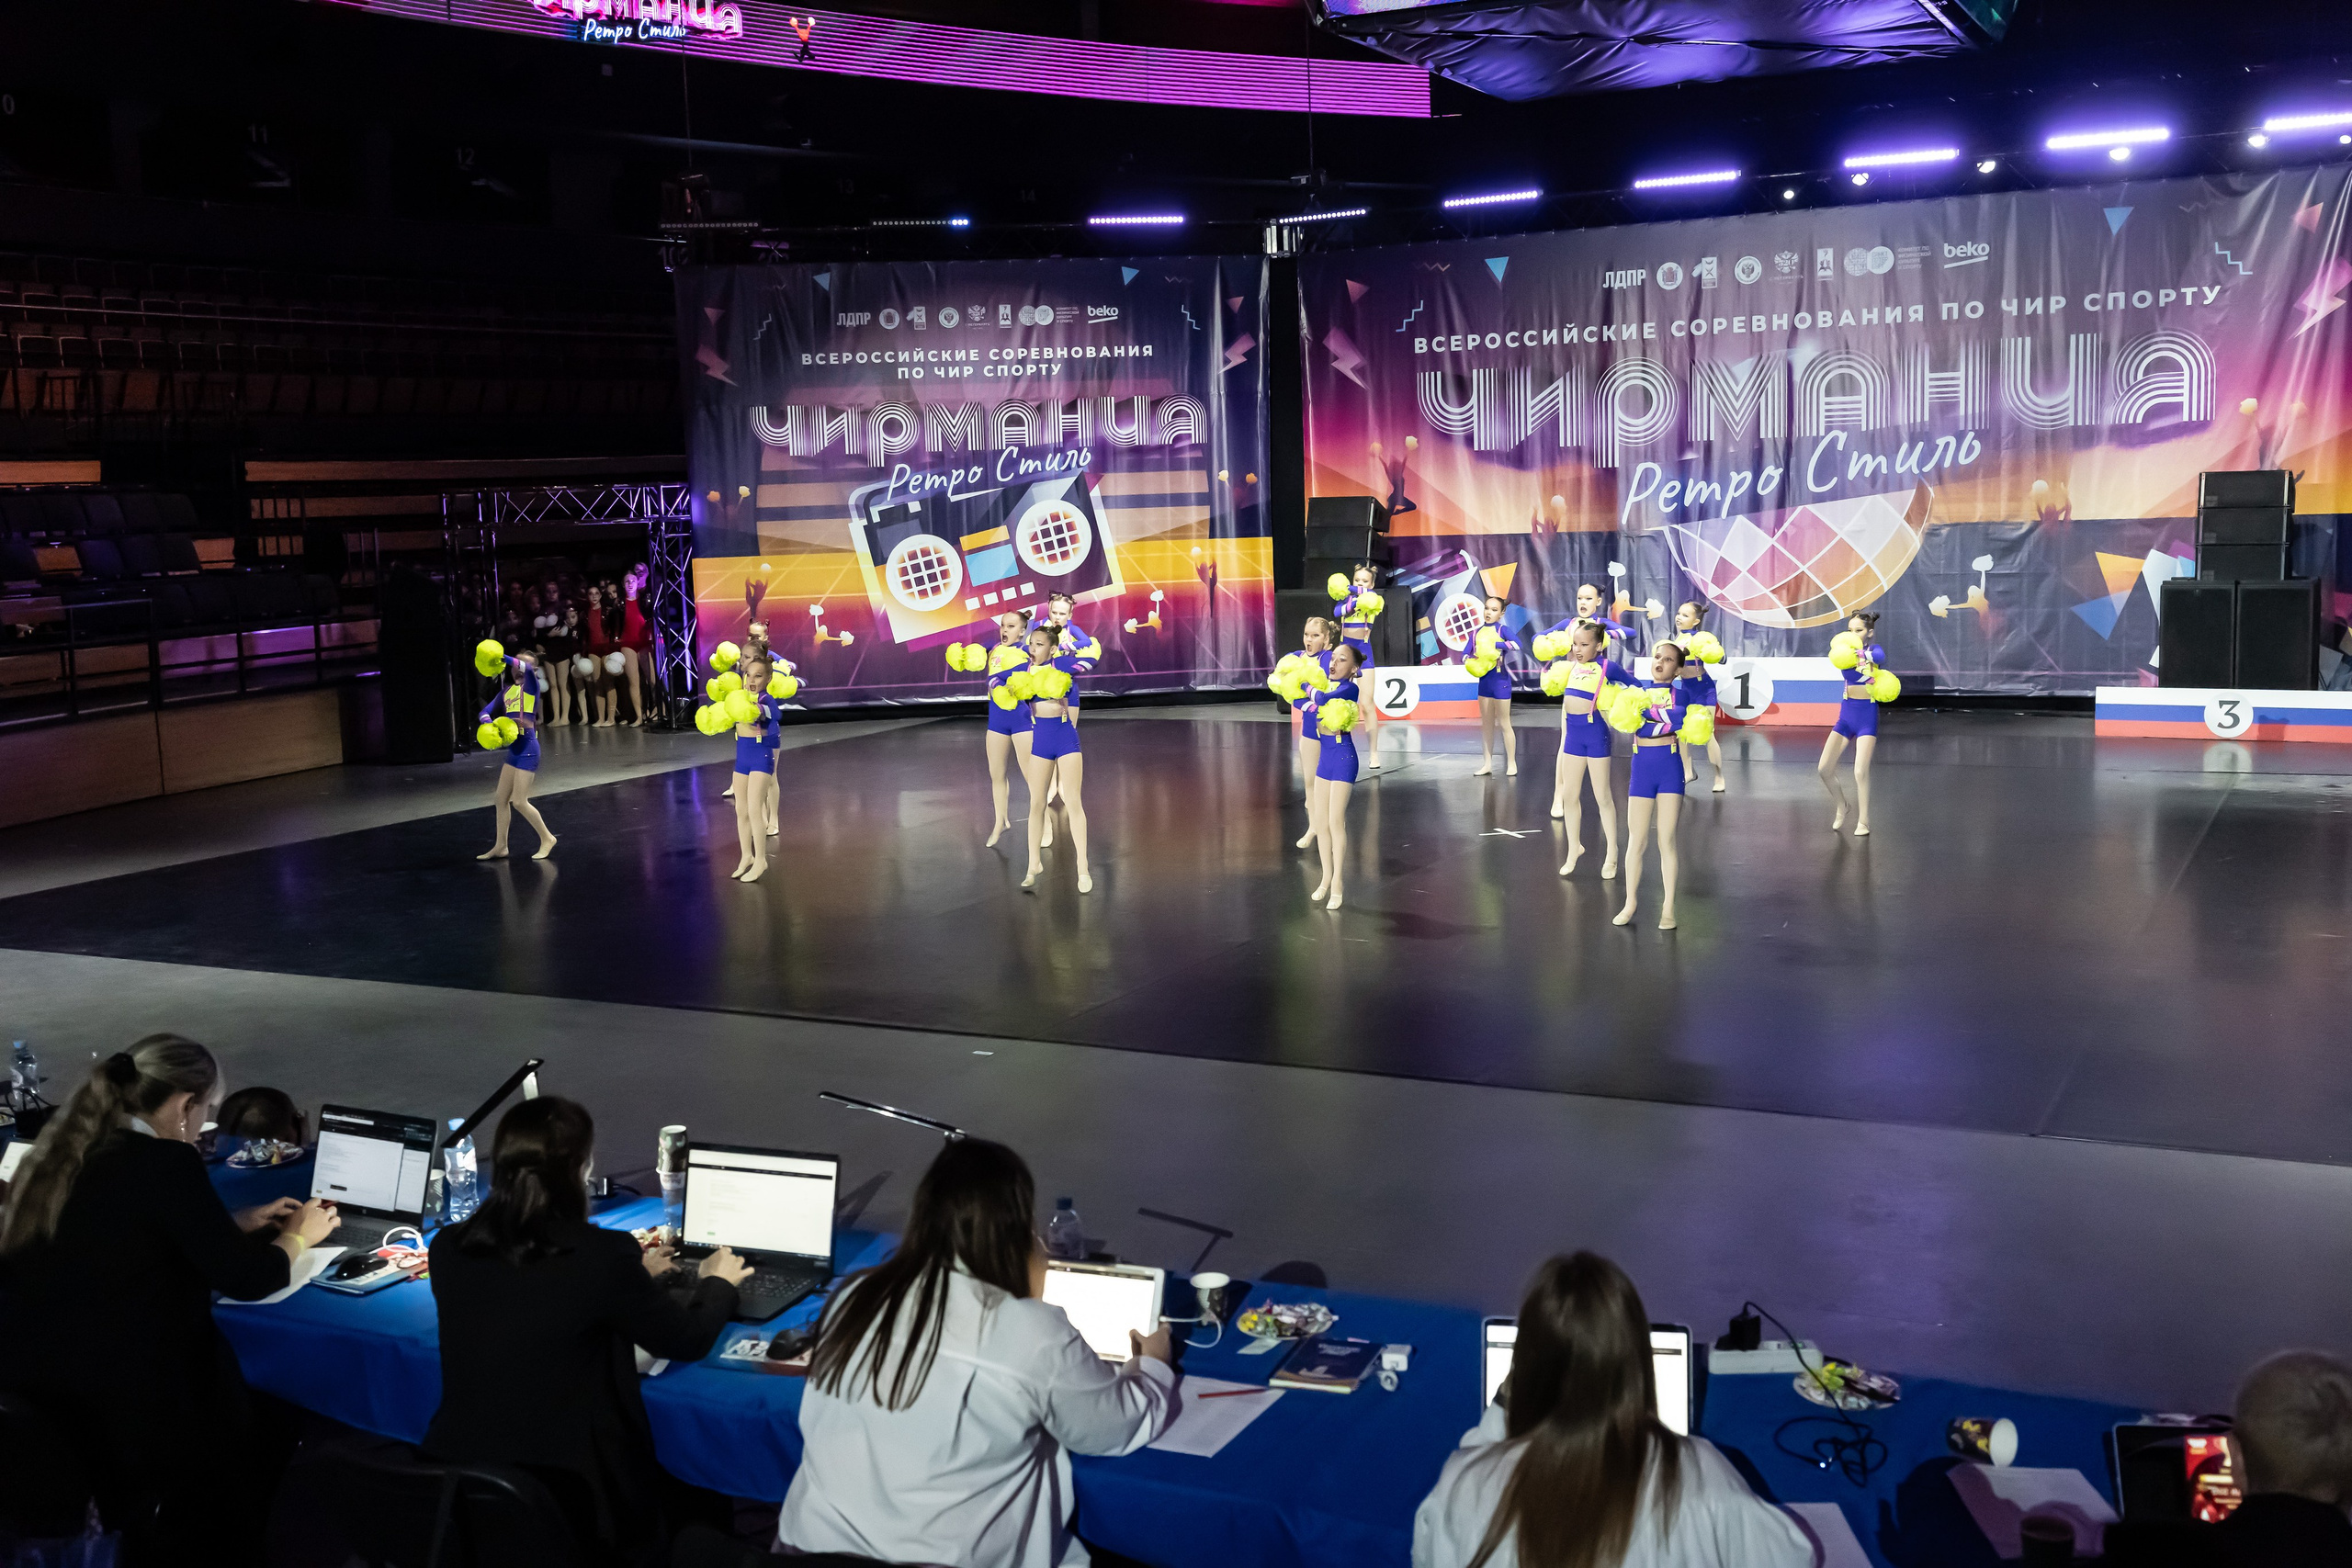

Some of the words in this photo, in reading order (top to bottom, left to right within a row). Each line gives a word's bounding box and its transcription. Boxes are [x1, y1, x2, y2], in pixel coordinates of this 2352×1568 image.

[583, 18, 632, 44] Ретро
[639, 17, 687, 39] Стиль
[1944, 241, 1990, 258] beko
[1603, 269, 1646, 289] ЛДПР
[837, 312, 871, 328] ЛДПР
[1088, 305, 1119, 317] beko
[1414, 321, 1657, 354] ВСЕРОССИЙСКИЕ
[1670, 304, 1925, 337] СОРЕВНОВАНИЯ
[1942, 300, 1984, 321] ПО
[2001, 295, 2067, 317] ЧИР
[2084, 285, 2222, 313] СПОРТУ
[801, 348, 979, 366] ВСЕРОССИЙСКИЕ
[989, 344, 1154, 360] СОРЕВНОВАНИЯ
[898, 366, 925, 379] ПО
[933, 364, 973, 378] ЧИР
[982, 363, 1062, 378] СПОРТУ
[887, 463, 982, 502] Ретро
[995, 446, 1092, 482] Стиль
[1622, 460, 1782, 525] Ретро
[1806, 431, 1982, 493] Стиль
[1385, 678, 1408, 709] 2
[1734, 672, 1755, 709] 1
[2217, 700, 2241, 729] 3
